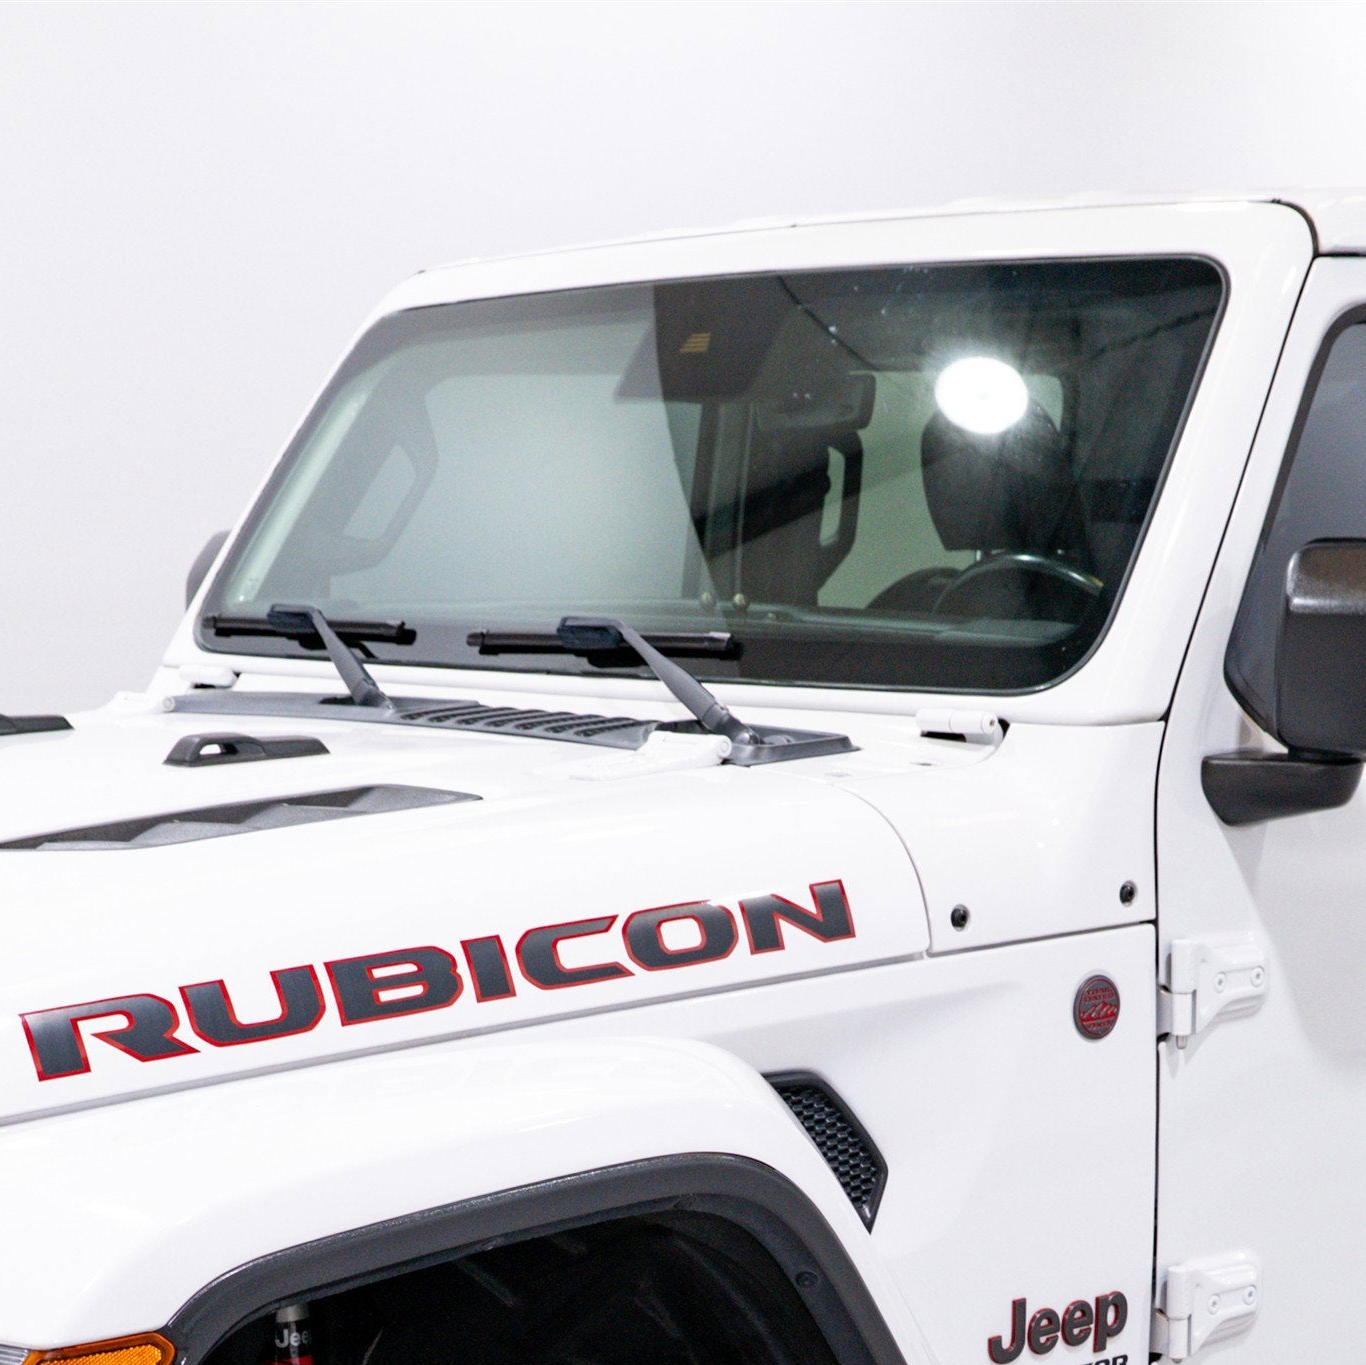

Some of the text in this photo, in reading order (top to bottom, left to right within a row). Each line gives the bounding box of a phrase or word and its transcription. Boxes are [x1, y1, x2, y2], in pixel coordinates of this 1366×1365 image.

[18, 878, 857, 1083] RUBICON
[274, 1327, 313, 1349] Jee
[987, 1290, 1128, 1365] Jeep
